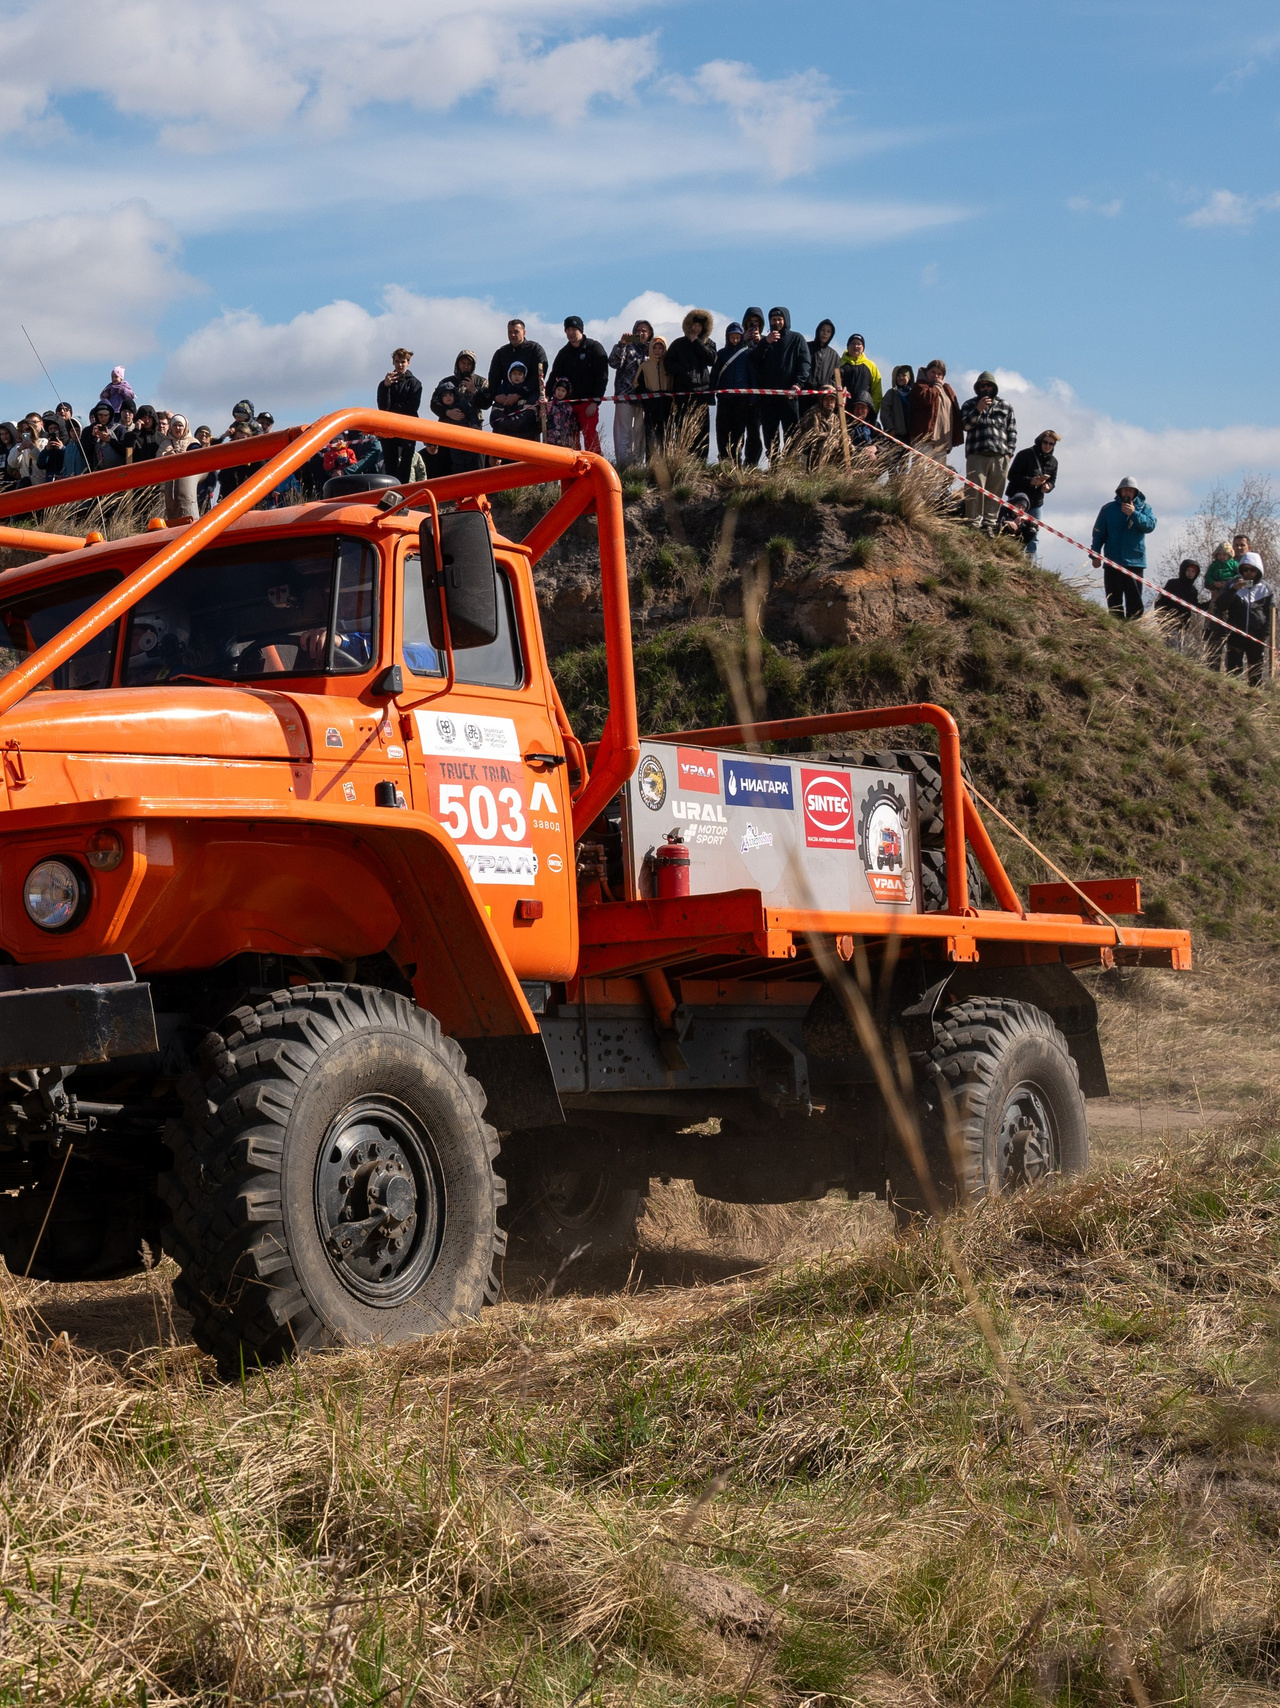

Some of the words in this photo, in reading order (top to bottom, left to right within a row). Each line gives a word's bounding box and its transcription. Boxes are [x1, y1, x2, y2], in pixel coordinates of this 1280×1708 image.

[439, 763, 479, 781] TRUCK
[482, 765, 515, 783] TRIAL
[680, 763, 716, 779] УРАЛ
[740, 778, 788, 795] НИАГАРА
[672, 800, 727, 823] URAL
[808, 795, 849, 814] SINTEC
[439, 784, 526, 842] 503
[533, 819, 560, 832] завод
[698, 824, 728, 836] MOTOR
[696, 834, 725, 846] SPORT
[873, 878, 903, 890] УРАЛ
